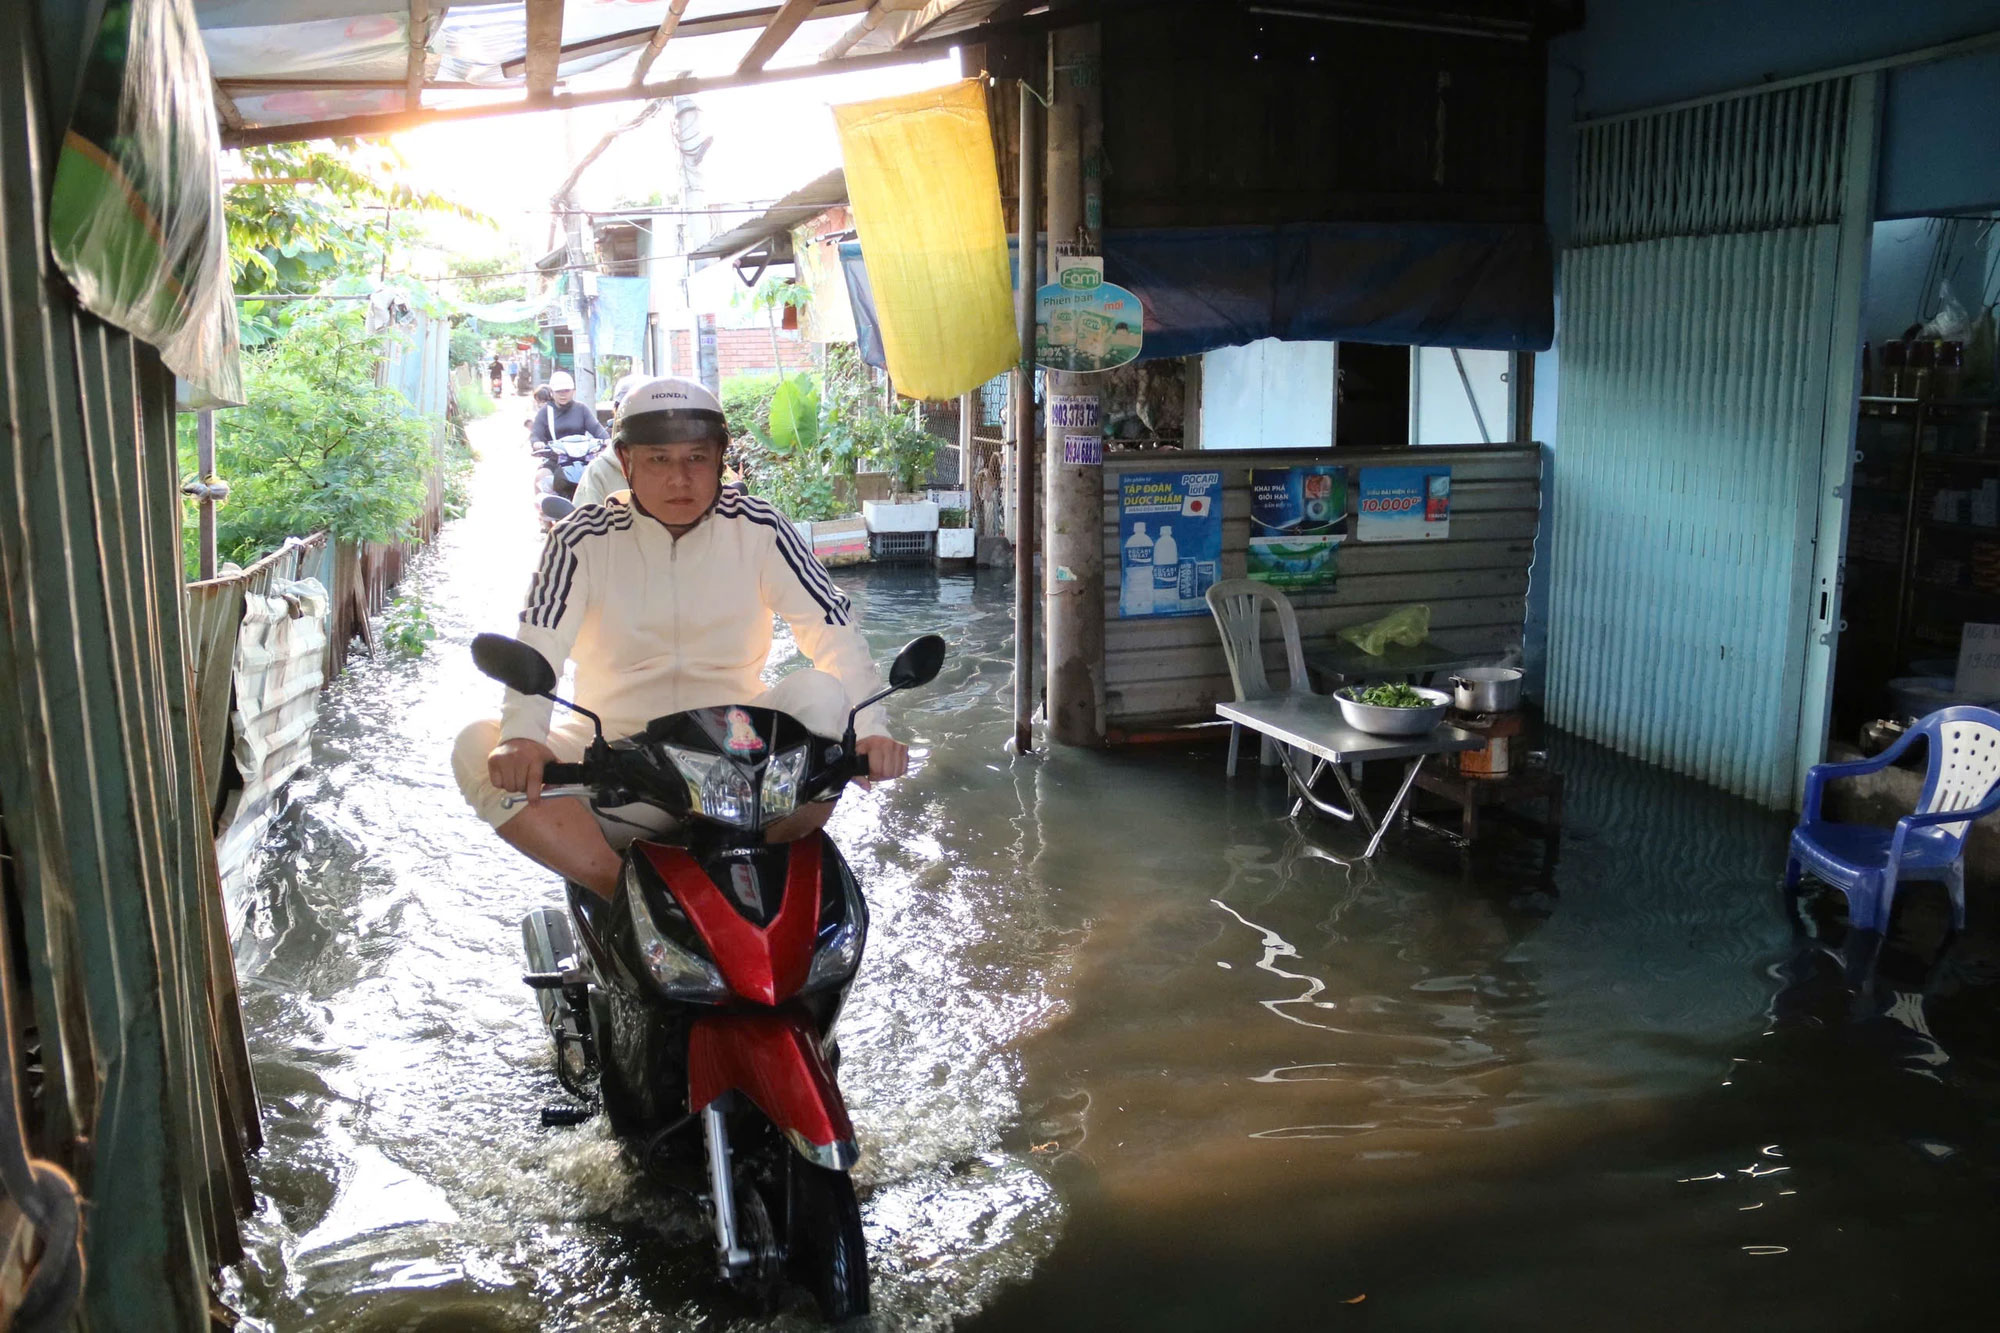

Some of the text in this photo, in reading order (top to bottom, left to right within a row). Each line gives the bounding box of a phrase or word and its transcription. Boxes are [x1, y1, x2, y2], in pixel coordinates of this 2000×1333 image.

[1062, 271, 1099, 284] Fami
[652, 392, 688, 400] HONDA
[1182, 474, 1218, 485] POCARI
[1143, 483, 1172, 493] ĐOÀN
